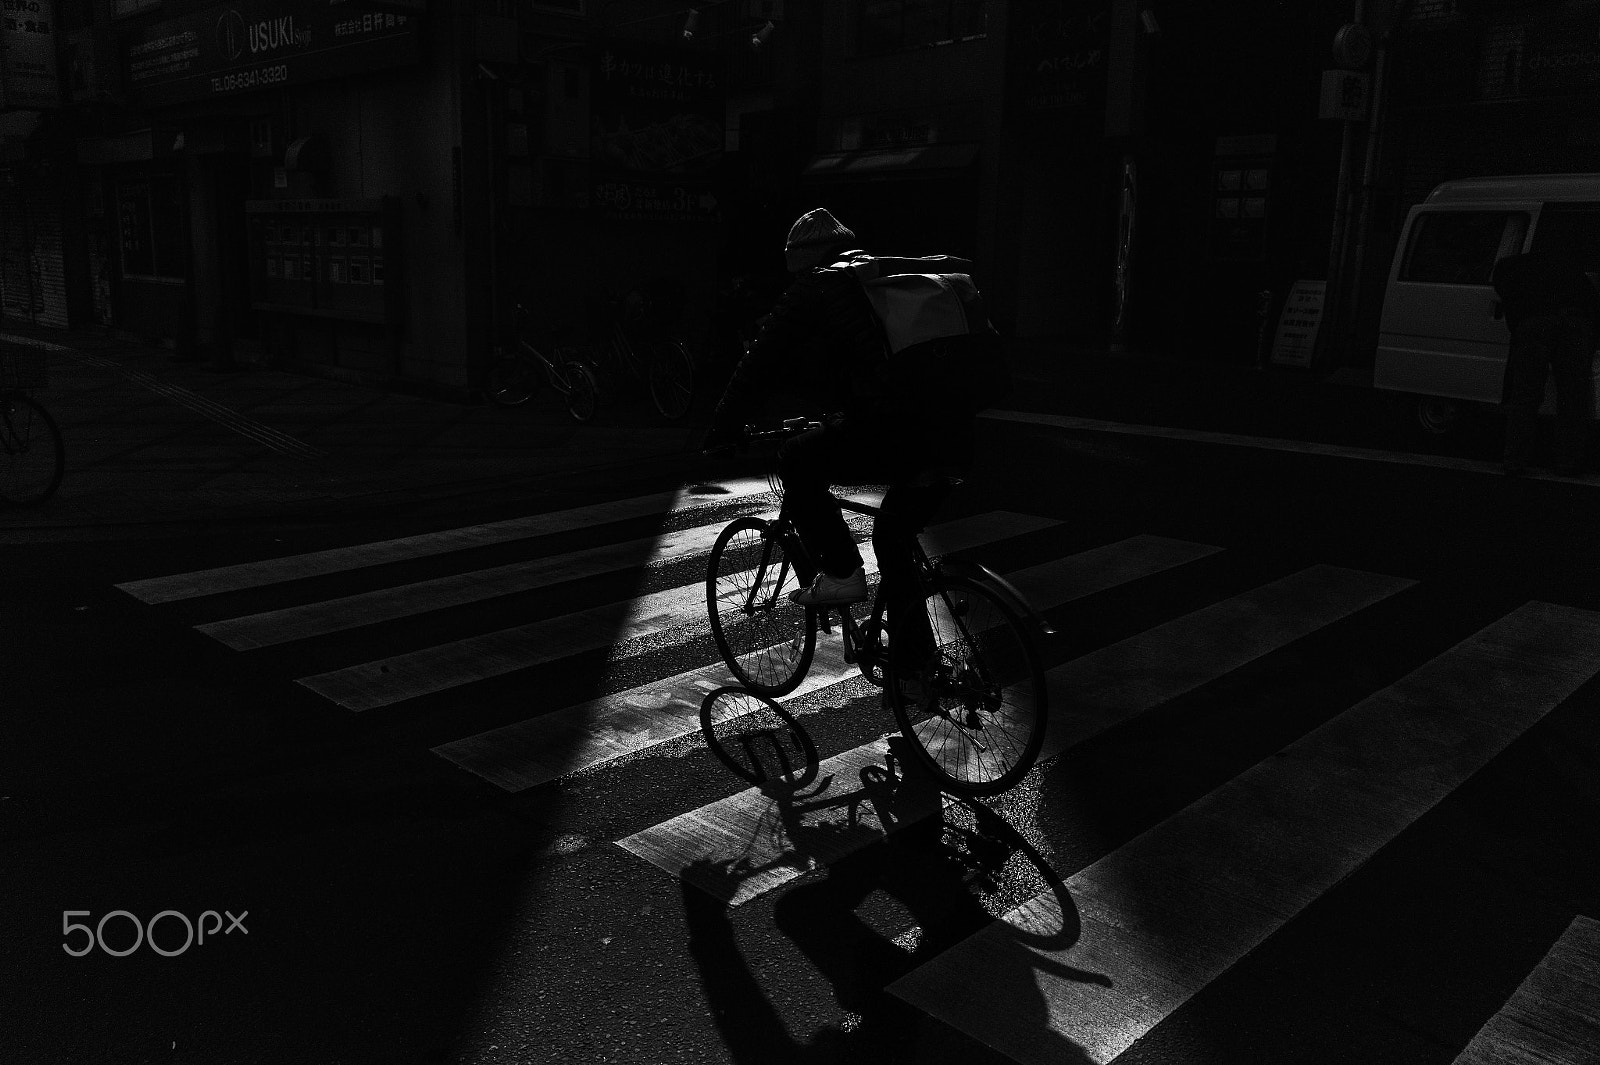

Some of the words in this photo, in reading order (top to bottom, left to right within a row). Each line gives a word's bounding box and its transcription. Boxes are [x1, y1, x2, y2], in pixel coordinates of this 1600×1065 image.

[249, 15, 294, 53] USUKI
[600, 49, 716, 90] 串カツは進化する
